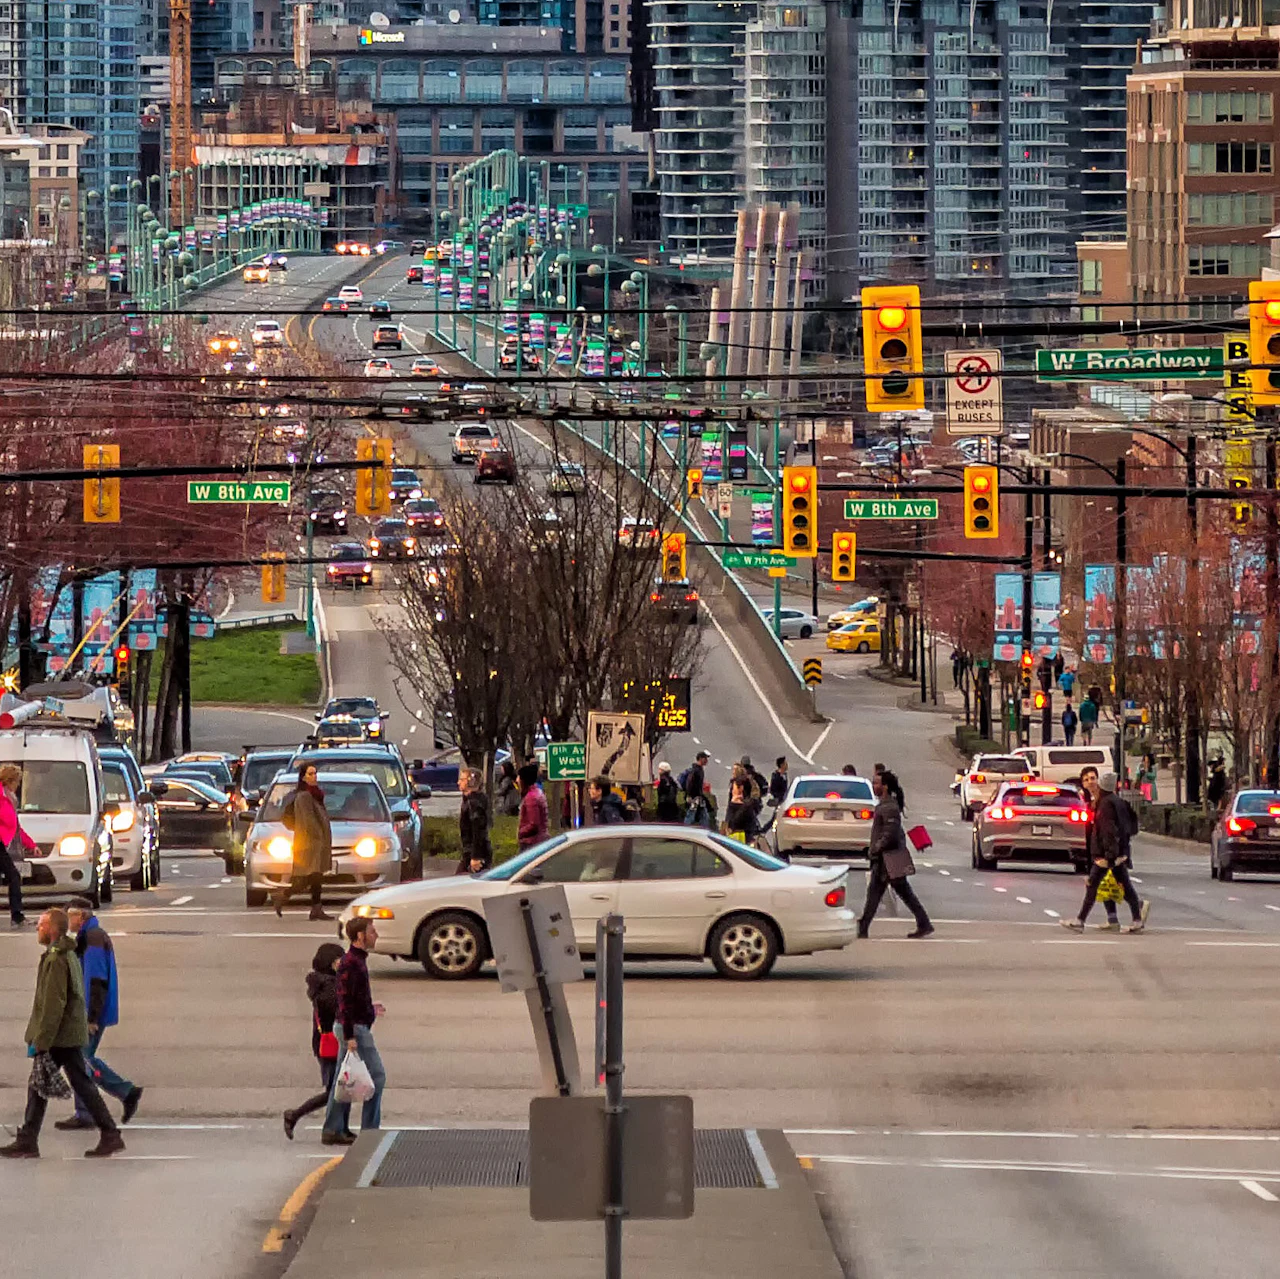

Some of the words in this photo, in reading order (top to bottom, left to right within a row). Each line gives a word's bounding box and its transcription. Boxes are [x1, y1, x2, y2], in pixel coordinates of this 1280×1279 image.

[1050, 353, 1076, 371] W
[1087, 352, 1211, 376] Broadway
[955, 399, 994, 410] EXCEPT
[958, 413, 993, 423] BUSES
[195, 485, 211, 499] W
[218, 485, 246, 499] 8th
[253, 485, 284, 499] Ave
[850, 504, 864, 516] W
[872, 503, 897, 516] 8th
[904, 503, 931, 516] Ave
[743, 556, 752, 565] W
[754, 556, 767, 565] 7th
